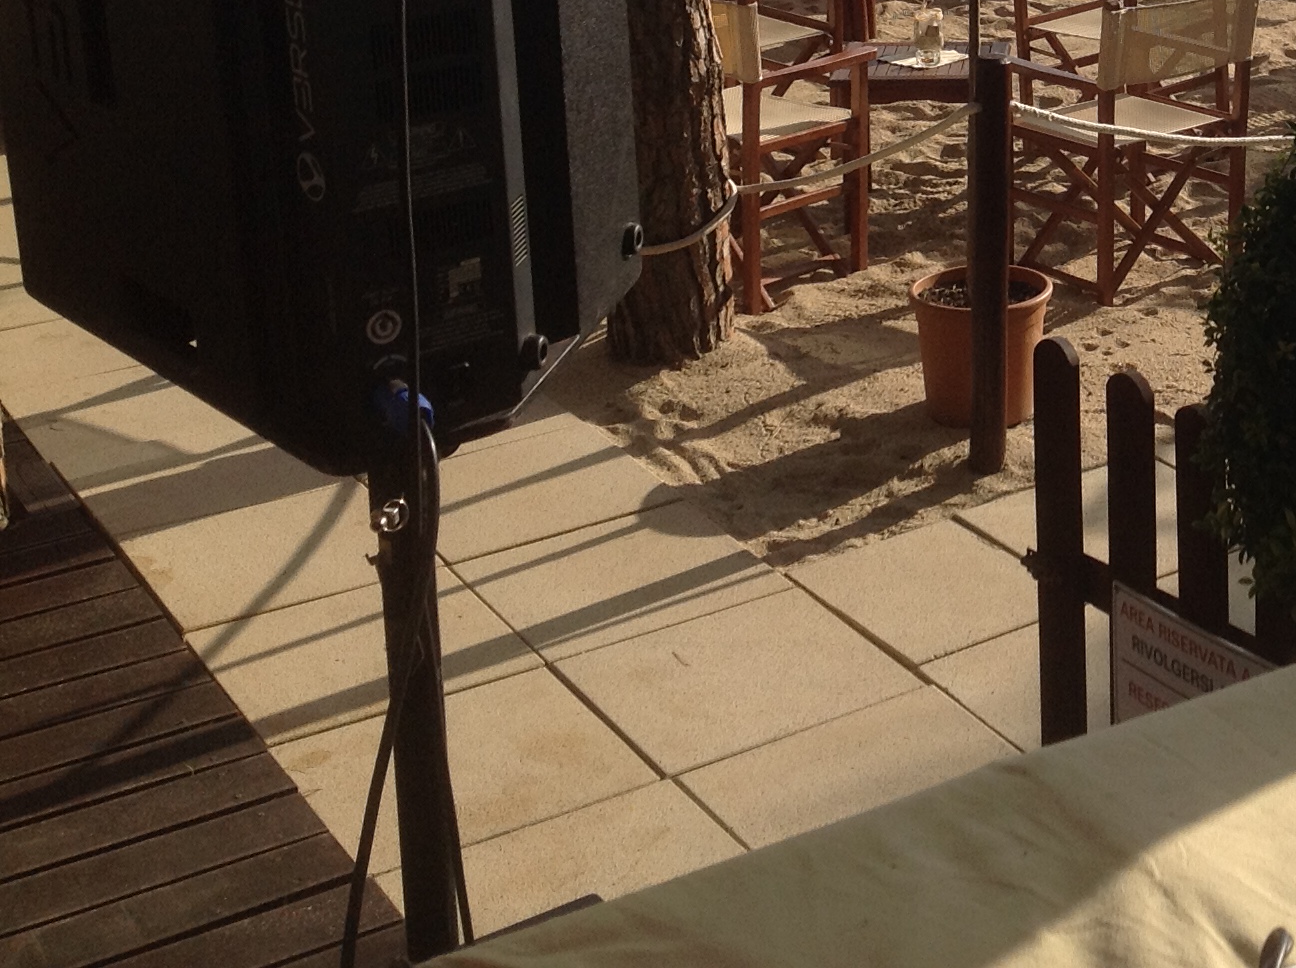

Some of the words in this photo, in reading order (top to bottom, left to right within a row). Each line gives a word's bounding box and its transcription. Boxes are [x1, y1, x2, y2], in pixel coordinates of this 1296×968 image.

[1120, 602, 1154, 633] AREA
[1159, 623, 1237, 681] RISERVATA
[1132, 634, 1213, 693] RIVOLGERSI
